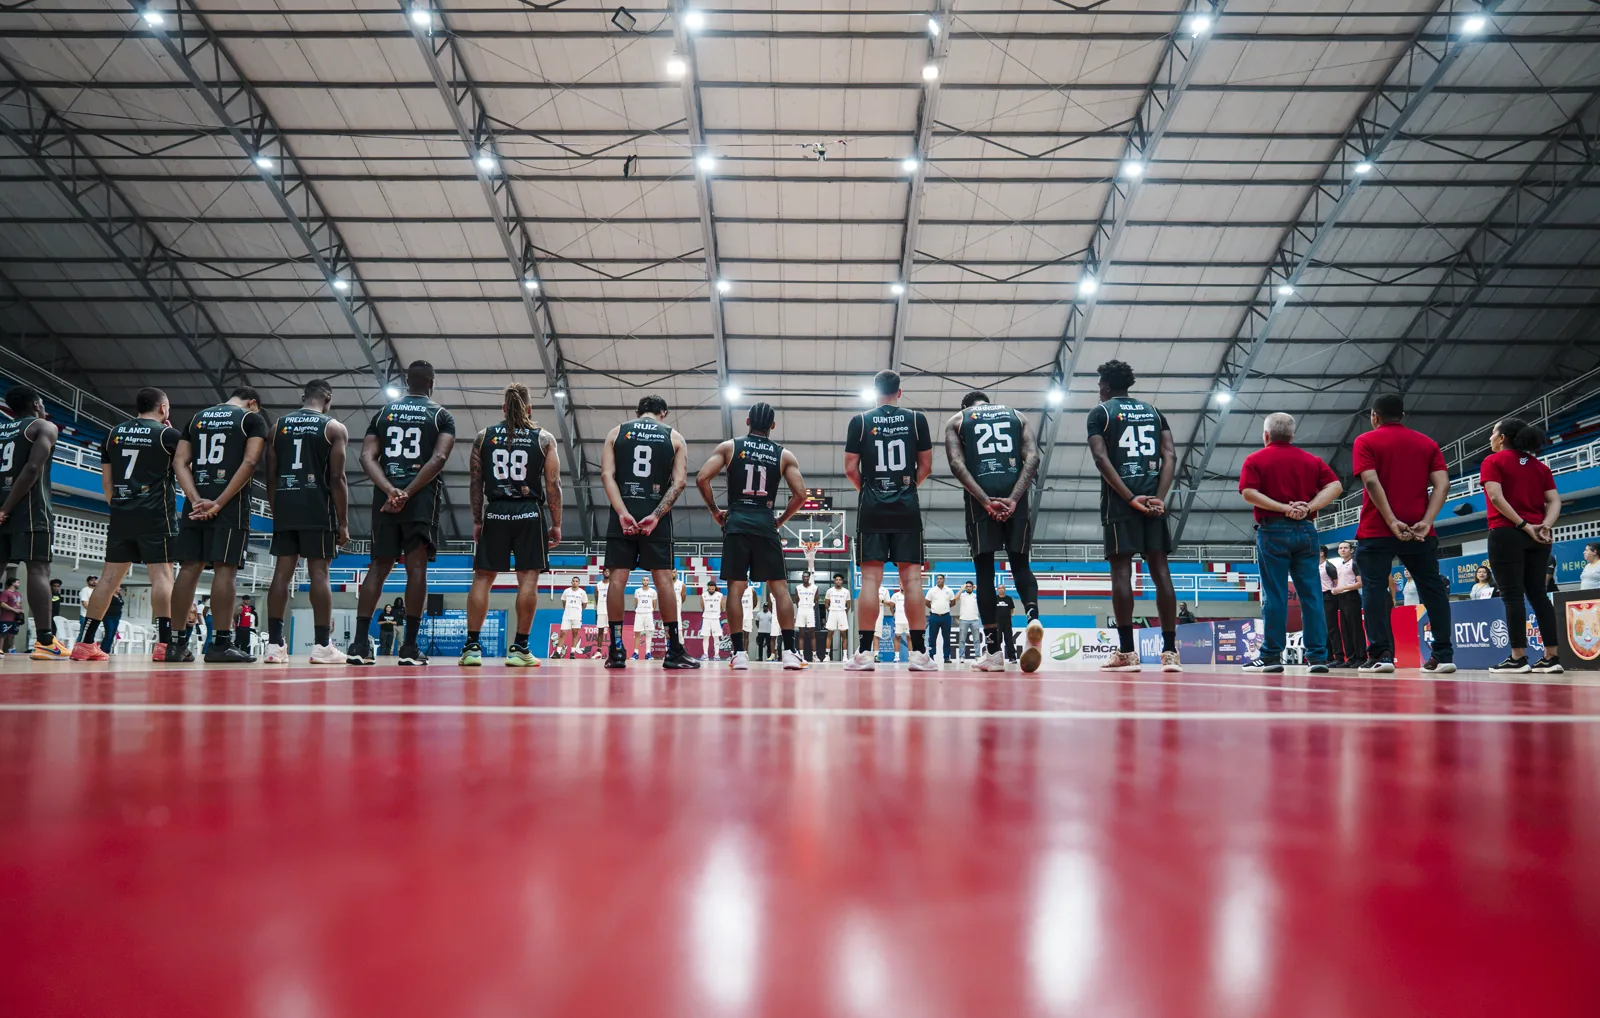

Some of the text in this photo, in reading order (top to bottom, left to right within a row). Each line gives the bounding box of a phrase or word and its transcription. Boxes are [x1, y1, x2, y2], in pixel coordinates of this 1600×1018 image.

[285, 416, 319, 424] PRECIADO
[399, 413, 426, 421] Algreco
[873, 415, 905, 424] QUINTERO
[207, 420, 234, 428] Algreco
[294, 426, 318, 434] Algreco
[634, 422, 658, 431] RUIZ
[883, 426, 909, 434] Algreco
[118, 426, 151, 435] BLANCO
[637, 432, 665, 440] Algreco
[385, 426, 422, 459] 33
[974, 421, 1013, 455] 25
[1119, 425, 1156, 457] 45
[197, 433, 226, 465] 16
[743, 440, 774, 452] MOJICA
[0, 441, 15, 472] 9
[292, 439, 302, 470] 1
[751, 451, 777, 462] Algreco
[875, 439, 906, 471] 10
[122, 449, 140, 479] 7
[492, 448, 528, 480] 88
[633, 445, 652, 478] 8
[742, 464, 768, 496] 11
[487, 511, 539, 520] Smart muscle
[1457, 563, 1478, 573] RADIO
[1454, 621, 1489, 643] RTVC
